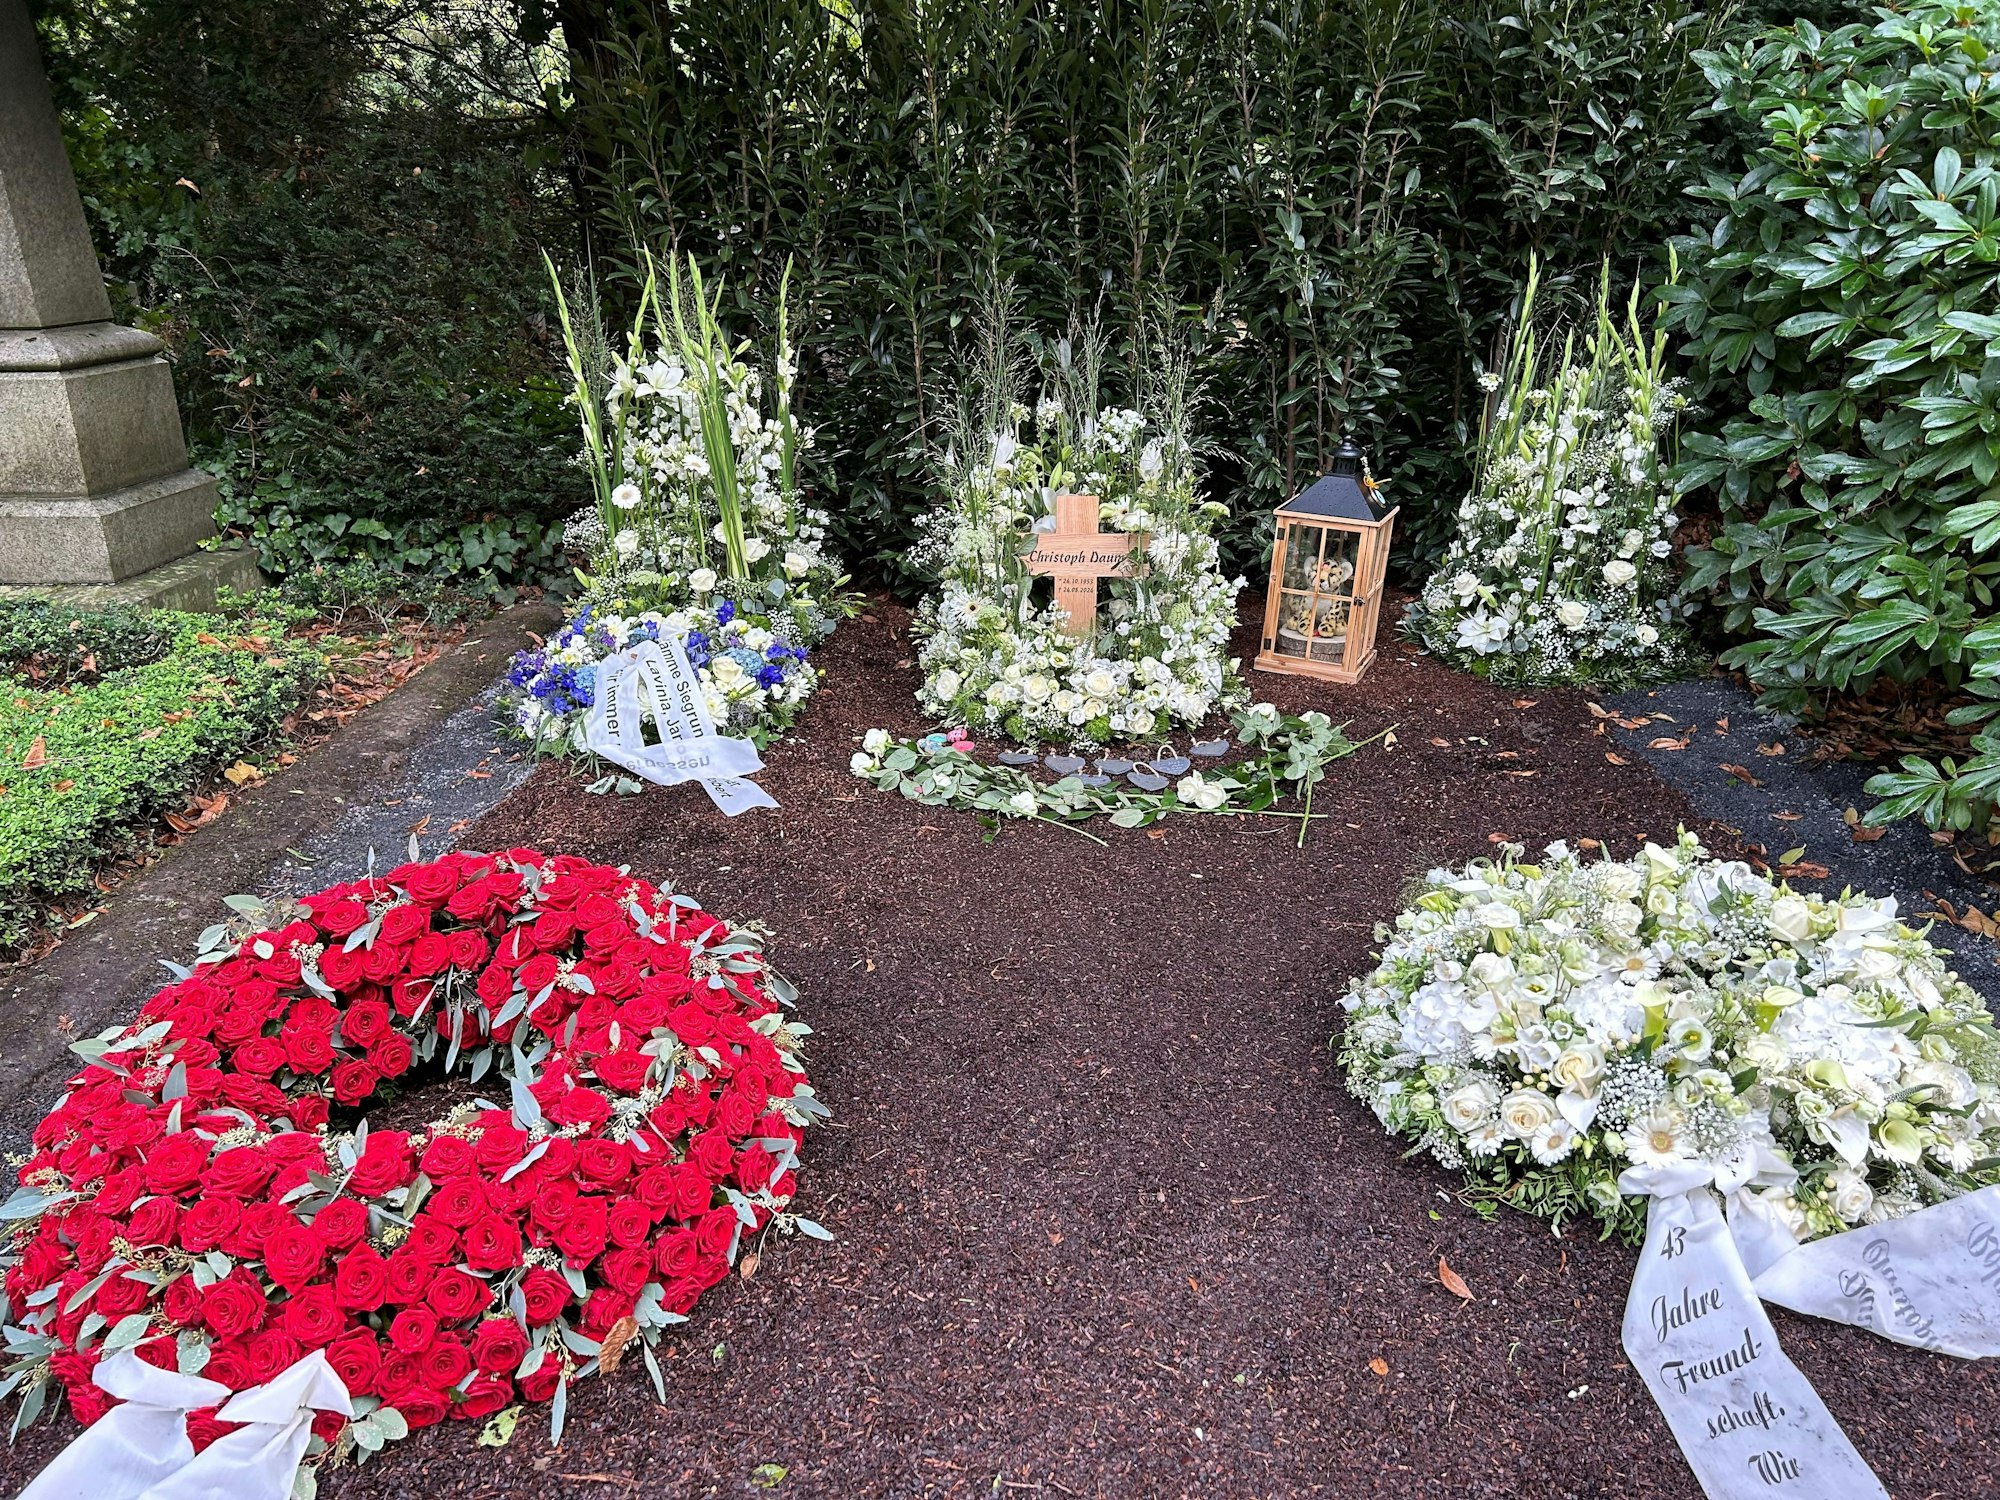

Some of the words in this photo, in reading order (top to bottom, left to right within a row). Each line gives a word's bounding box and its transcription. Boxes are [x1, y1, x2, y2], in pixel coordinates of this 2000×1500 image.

[1030, 550, 1085, 565] Christoph
[606, 685, 620, 737] immer
[646, 660, 672, 715] Lavinia,
[657, 639, 682, 680] ämme
[676, 680, 704, 738] Siegrun
[1660, 1226, 1687, 1261] 43
[1651, 1286, 1724, 1343] Jahre
[1660, 1327, 1762, 1395] Freund-
[1706, 1391, 1786, 1439] schaft.
[1748, 1450, 1801, 1486] Wir
